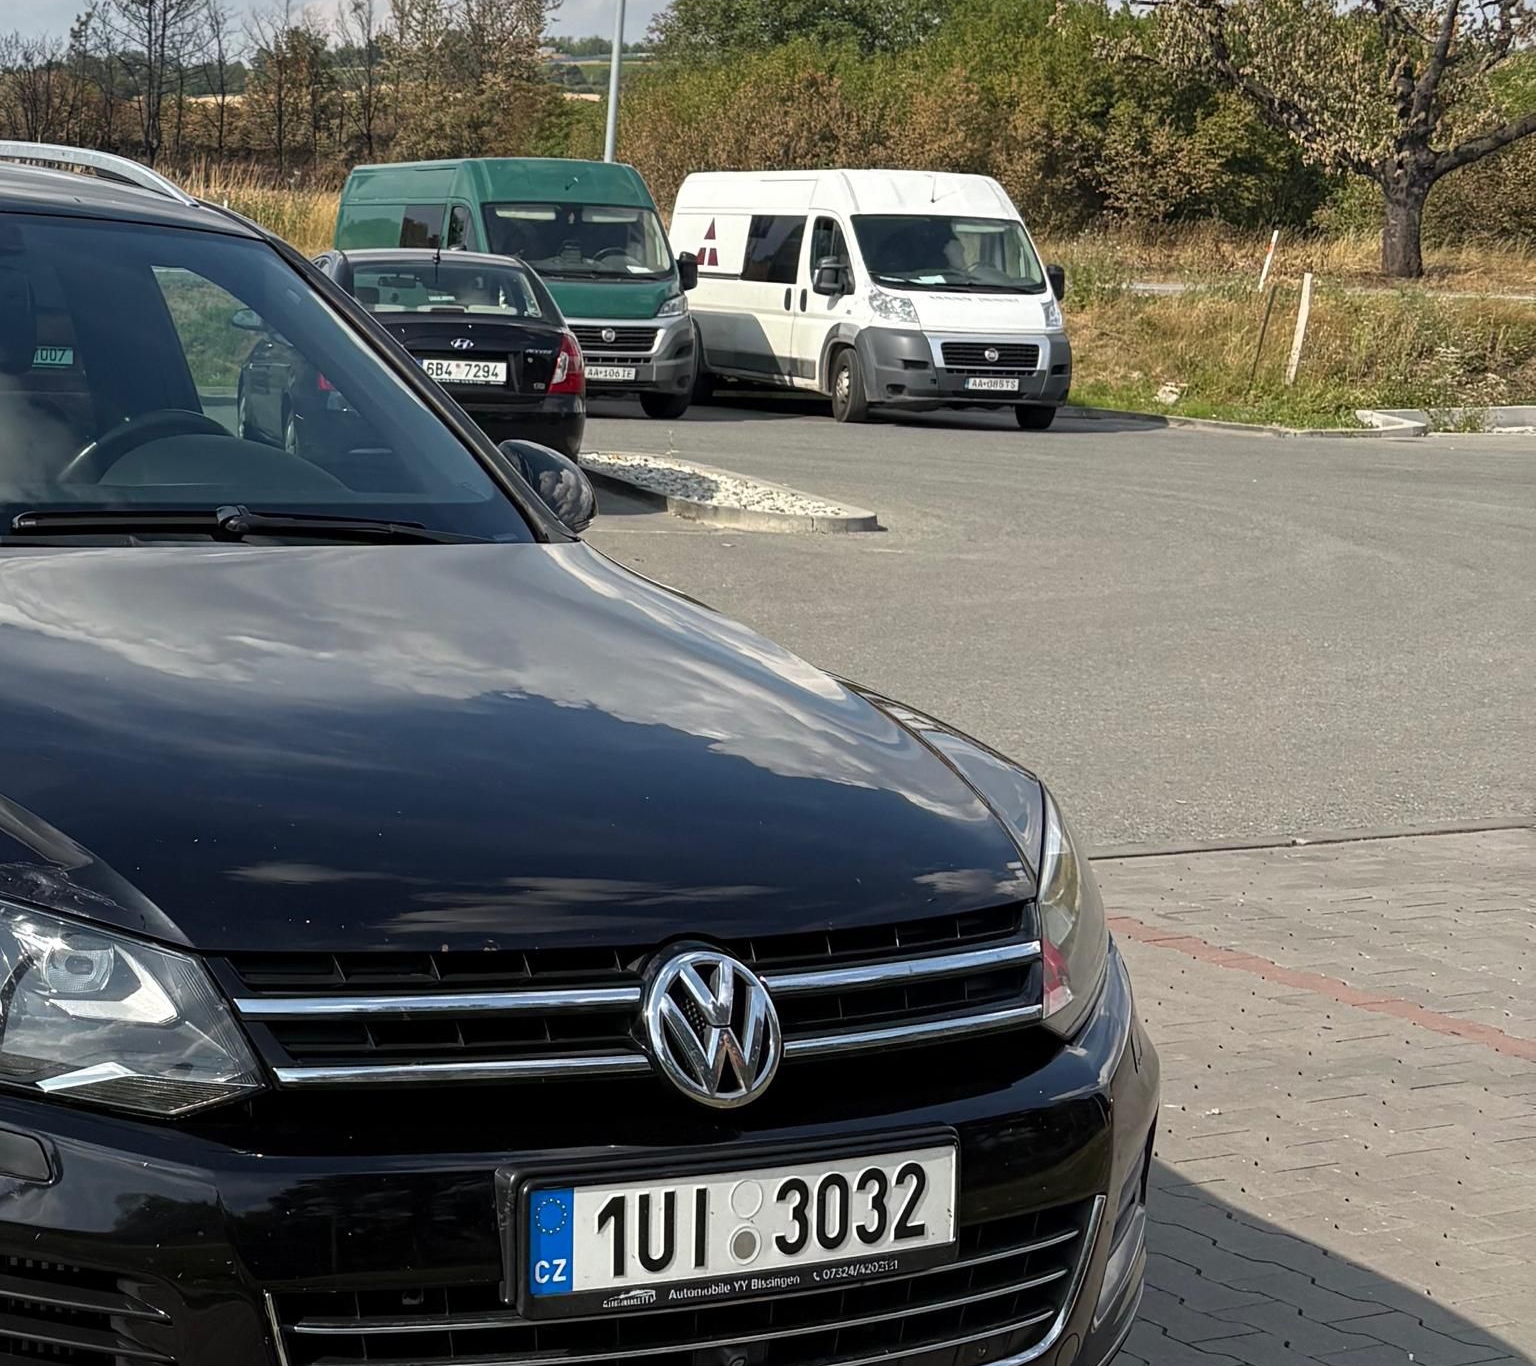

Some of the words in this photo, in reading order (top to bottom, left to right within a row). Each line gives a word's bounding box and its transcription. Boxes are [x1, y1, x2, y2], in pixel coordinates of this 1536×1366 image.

[426, 362, 453, 377] 6B4
[464, 363, 499, 379] 7294
[596, 1187, 708, 1278] 1UI
[774, 1161, 926, 1255] 3032
[534, 1258, 567, 1285] CZ
[668, 1282, 731, 1300] Automobile
[733, 1280, 749, 1292] YY
